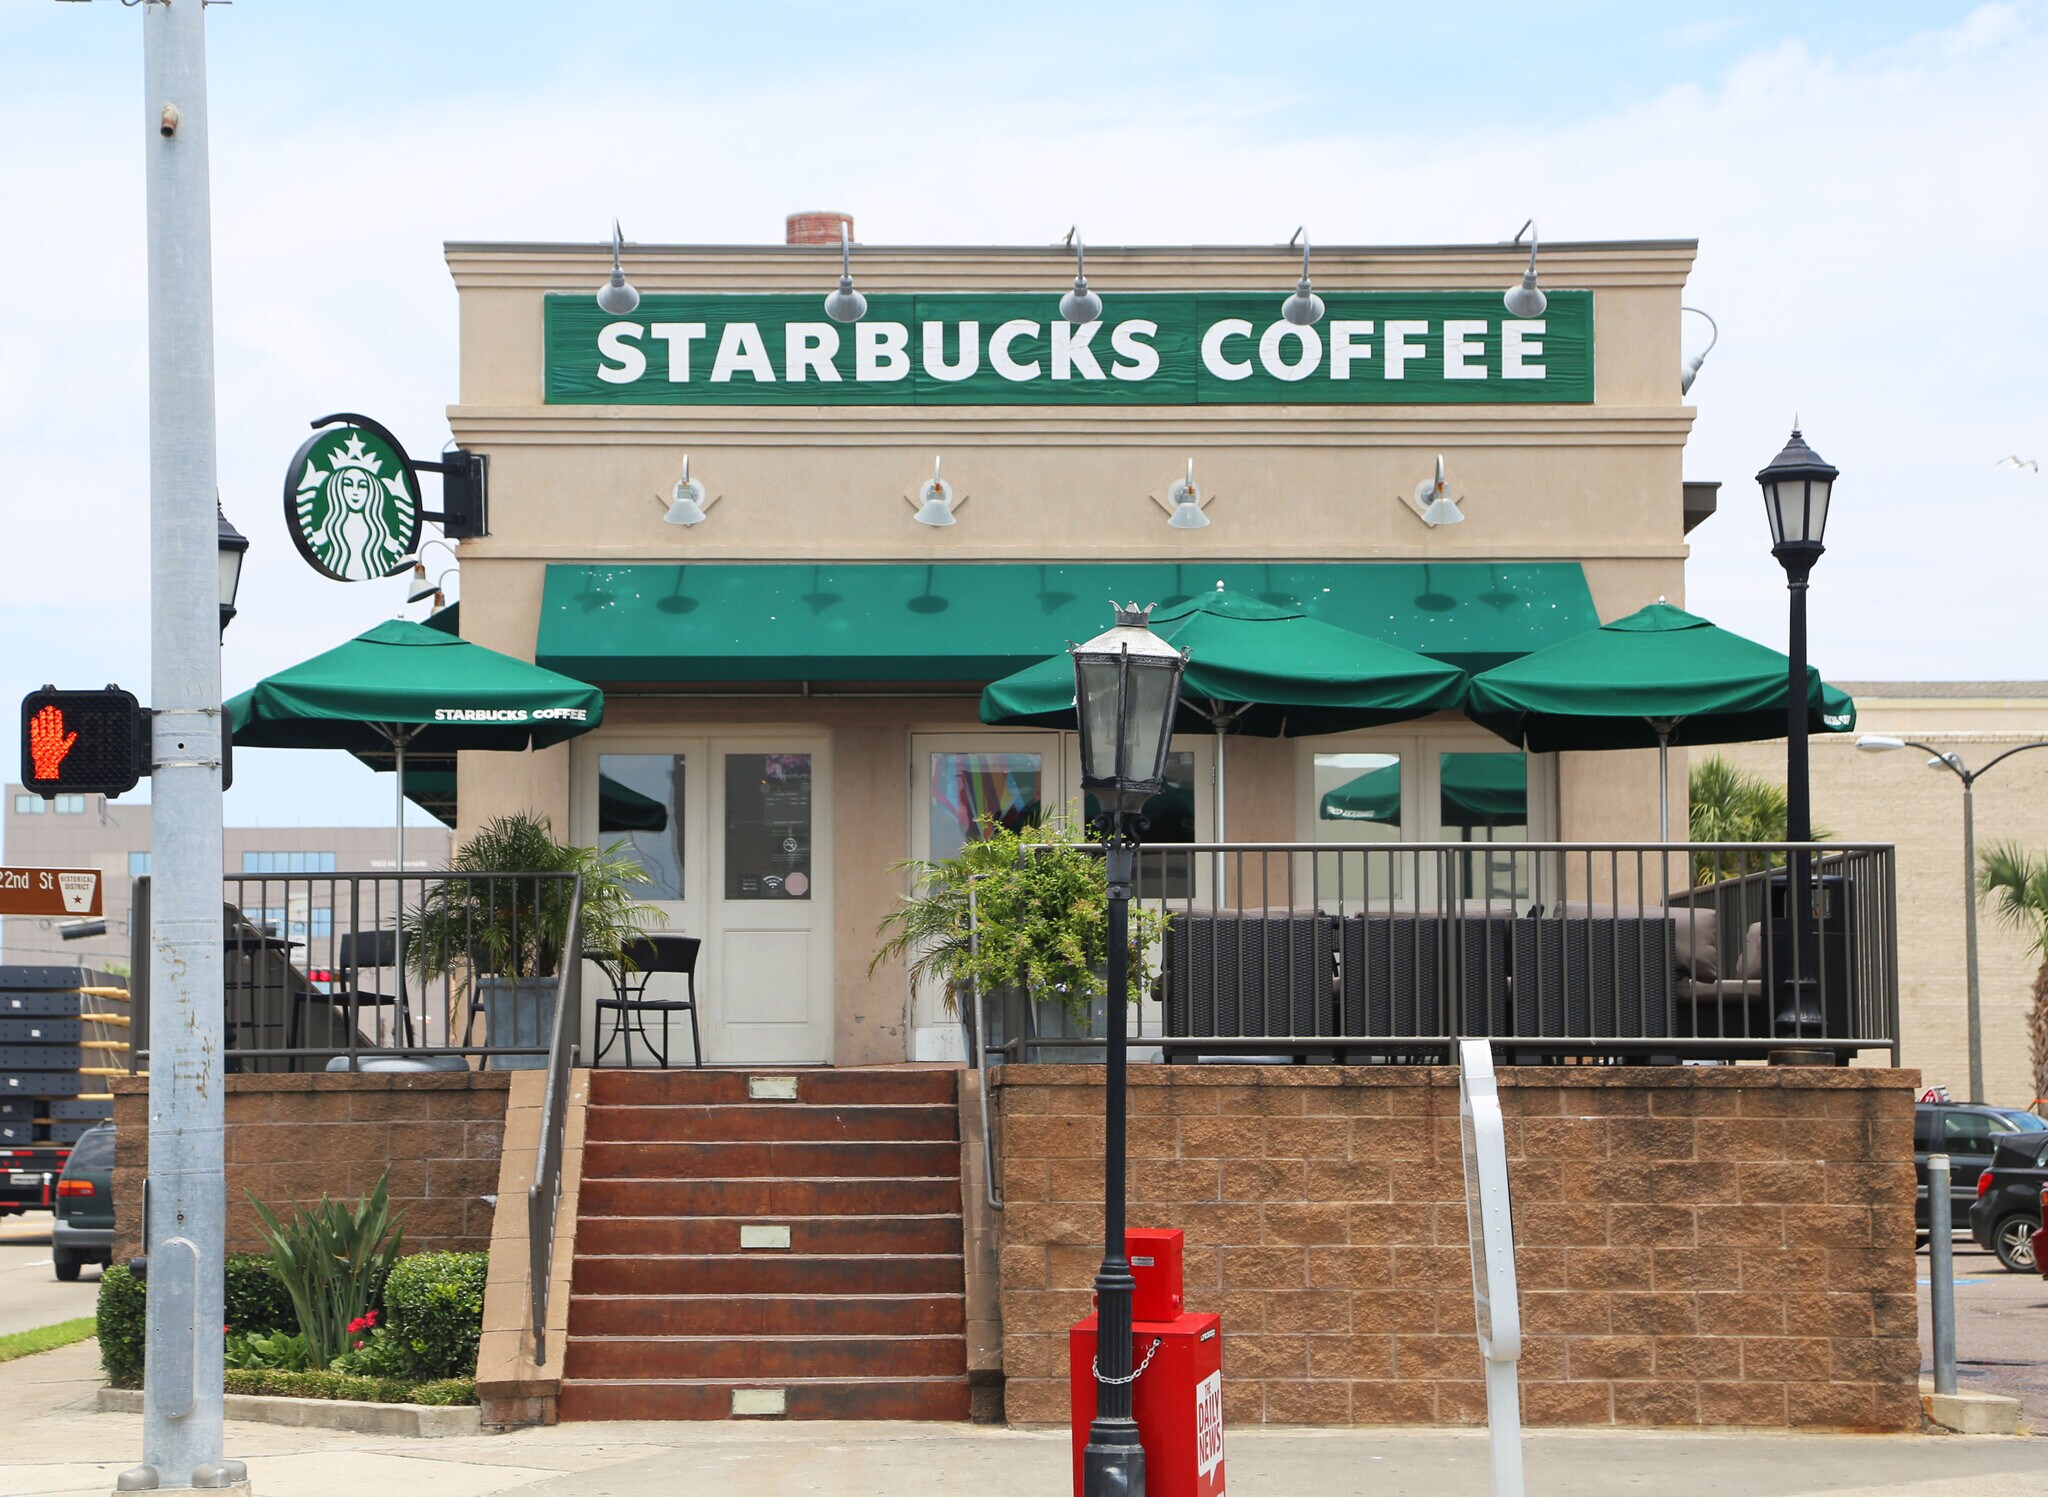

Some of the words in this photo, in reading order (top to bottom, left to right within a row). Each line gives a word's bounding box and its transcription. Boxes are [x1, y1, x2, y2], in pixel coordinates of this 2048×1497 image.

[597, 318, 1160, 384] STARBUCKS
[1201, 318, 1546, 382] COFFEE
[434, 708, 528, 721] STARBUCKS
[531, 707, 587, 721] COFFEE
[39, 872, 54, 890] St
[60, 875, 94, 883] HISTORICAL
[1204, 1381, 1212, 1396] THE
[1198, 1388, 1220, 1434] DAILY
[1199, 1421, 1221, 1466] NEWS
